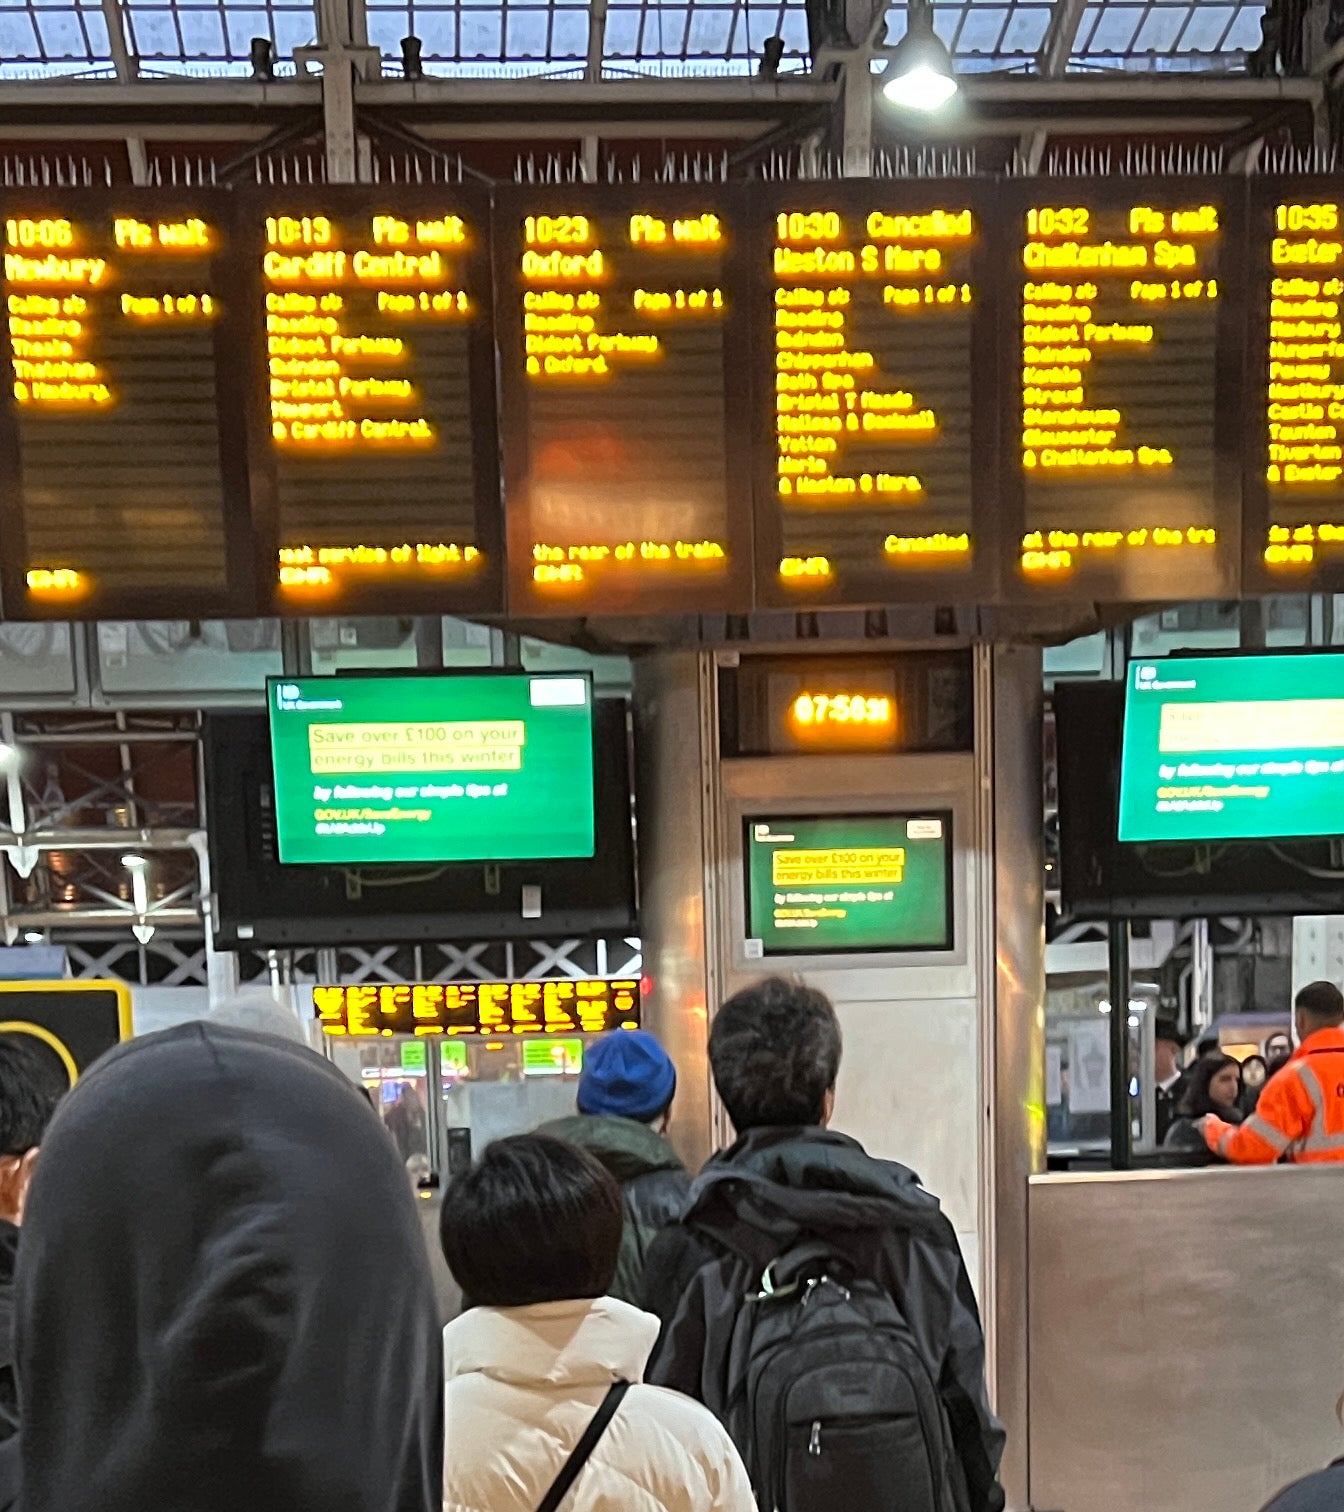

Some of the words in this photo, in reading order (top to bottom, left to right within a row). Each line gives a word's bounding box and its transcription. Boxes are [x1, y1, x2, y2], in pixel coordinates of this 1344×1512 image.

[266, 217, 331, 244] 10:13
[373, 217, 409, 244] Pls
[417, 216, 465, 244] wait
[525, 216, 589, 243] 10:23
[631, 215, 666, 243] Pls
[673, 214, 721, 242] wait
[777, 212, 839, 240] 10:30
[867, 210, 971, 237] Cancelled
[1028, 208, 1089, 235] 10:32
[1130, 208, 1165, 233] Pls
[1172, 206, 1218, 233] wait
[1277, 205, 1337, 231] 10:35
[115, 219, 153, 247] Pls
[160, 219, 208, 247] wait
[523, 250, 603, 277] Oxford
[774, 247, 855, 273] Weston
[861, 245, 878, 271] S
[885, 245, 940, 271] Mare
[1024, 242, 1147, 268] Cheltenham
[1154, 241, 1195, 268] Spa
[1273, 239, 1342, 263] Exeter
[5, 254, 106, 285] Newbury
[264, 251, 346, 280] Cardiff
[353, 251, 442, 279] Central
[313, 729, 354, 744] Save
[362, 731, 398, 742] over
[405, 727, 445, 742] £100
[453, 729, 474, 741] on
[481, 728, 518, 743] your
[314, 752, 373, 768] energy
[382, 750, 416, 765] bills
[422, 750, 454, 765] this
[461, 749, 515, 763] winter
[776, 855, 802, 864] Save
[805, 855, 828, 863] over
[831, 854, 856, 864] £100
[860, 854, 873, 863] on
[877, 854, 900, 866] your
[777, 869, 813, 881] energy
[816, 868, 837, 879] bills
[841, 868, 862, 878] this
[865, 868, 897, 877] winter
